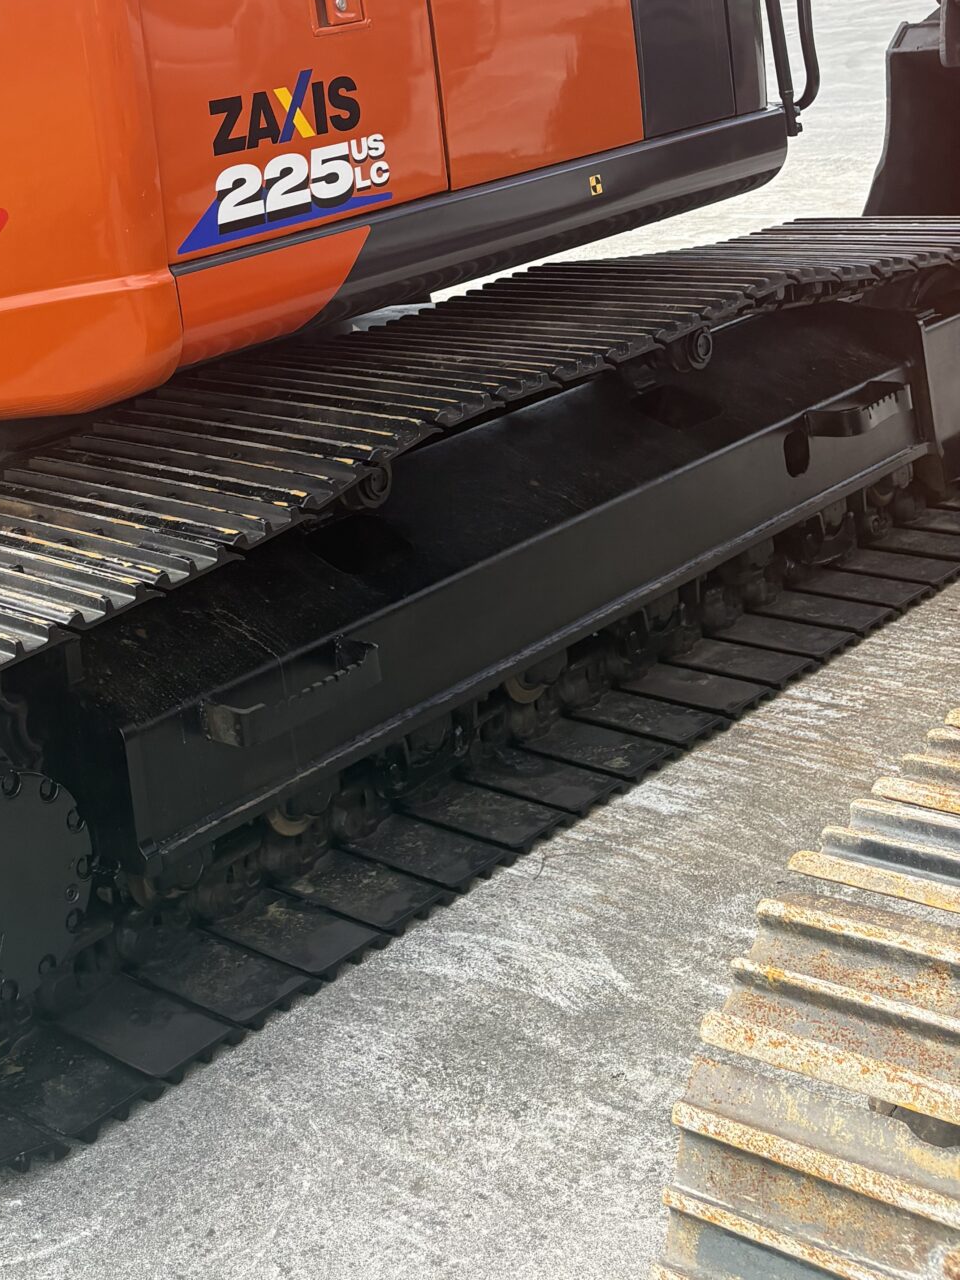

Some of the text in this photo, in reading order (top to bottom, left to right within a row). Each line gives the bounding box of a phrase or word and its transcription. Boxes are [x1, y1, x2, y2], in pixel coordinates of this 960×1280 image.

[208, 69, 361, 156] ZAXIS
[215, 133, 386, 234] 225 US
[354, 160, 390, 192] LC
